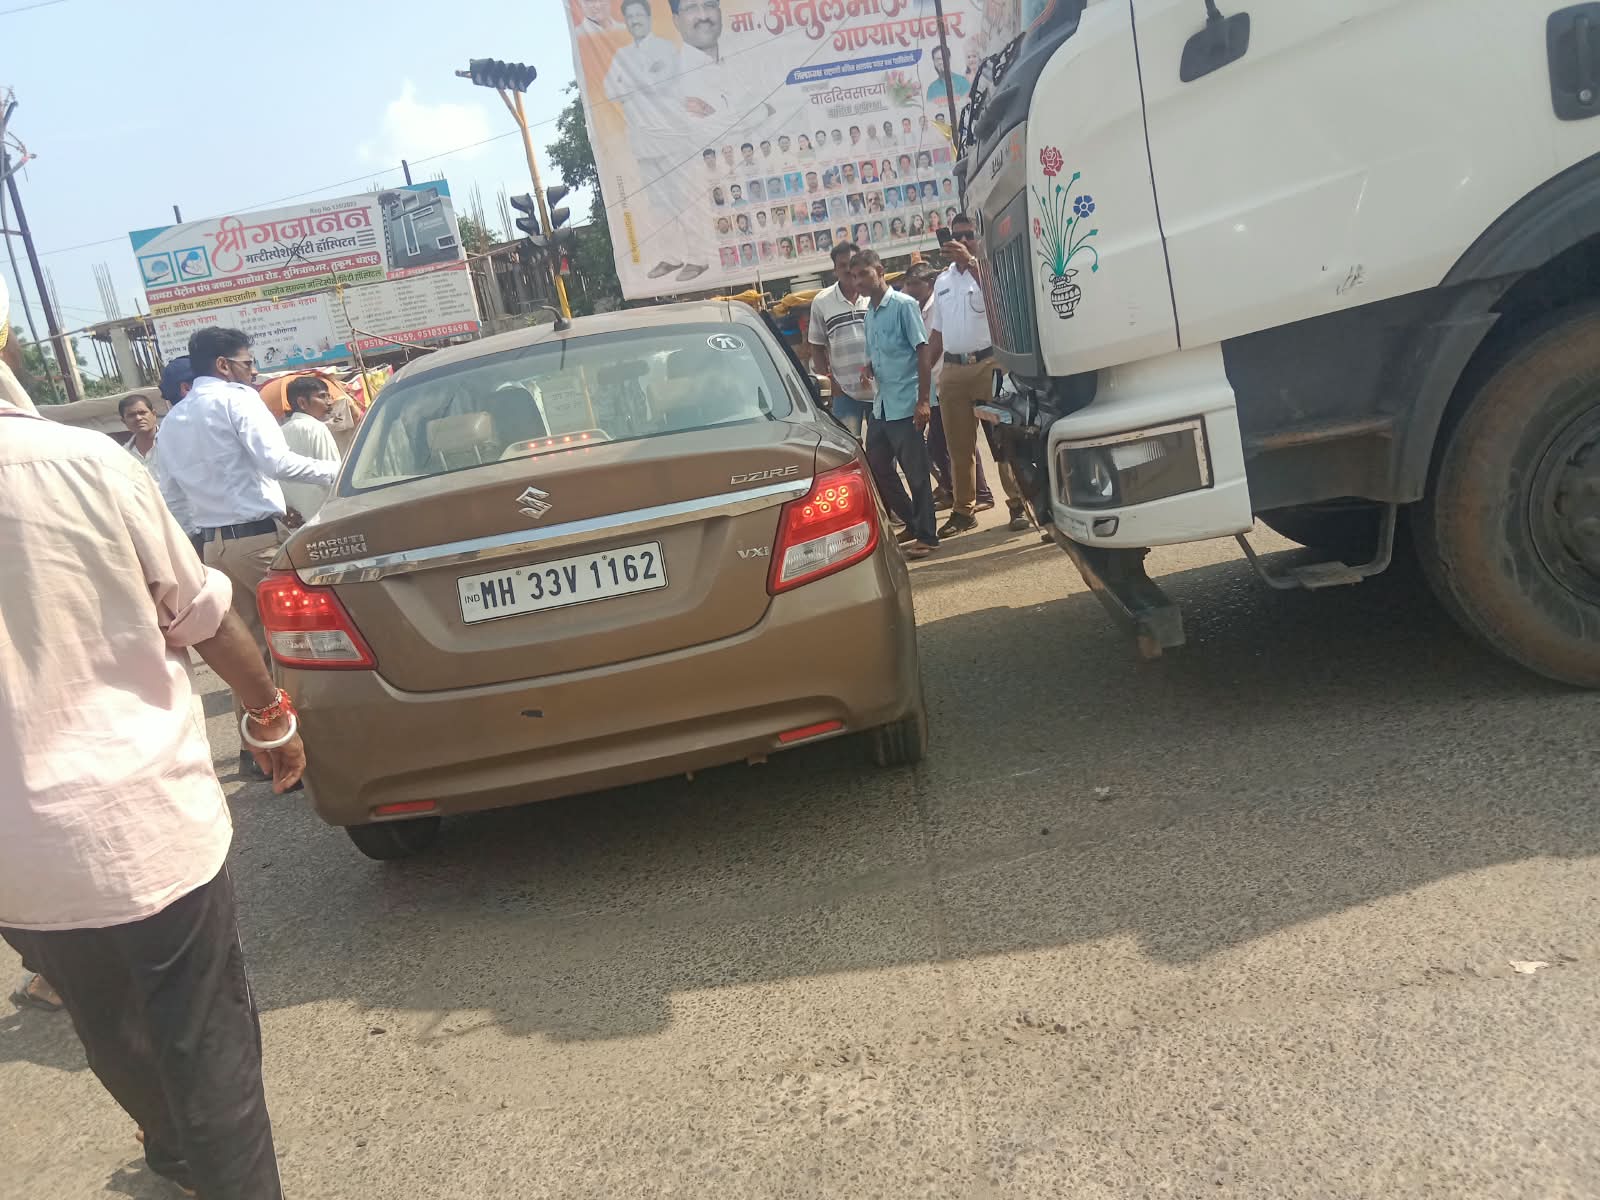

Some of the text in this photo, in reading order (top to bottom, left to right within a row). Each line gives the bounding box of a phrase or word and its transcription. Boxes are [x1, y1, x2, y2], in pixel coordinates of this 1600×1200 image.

[809, 83, 887, 105] वाढदिवसाच्या
[316, 236, 357, 253] हॉस्पिटल
[730, 465, 799, 485] DZIRE
[305, 534, 365, 551] MARUTI
[309, 542, 368, 560] SUZUKI
[464, 551, 657, 610] IND MH 33V 1162
